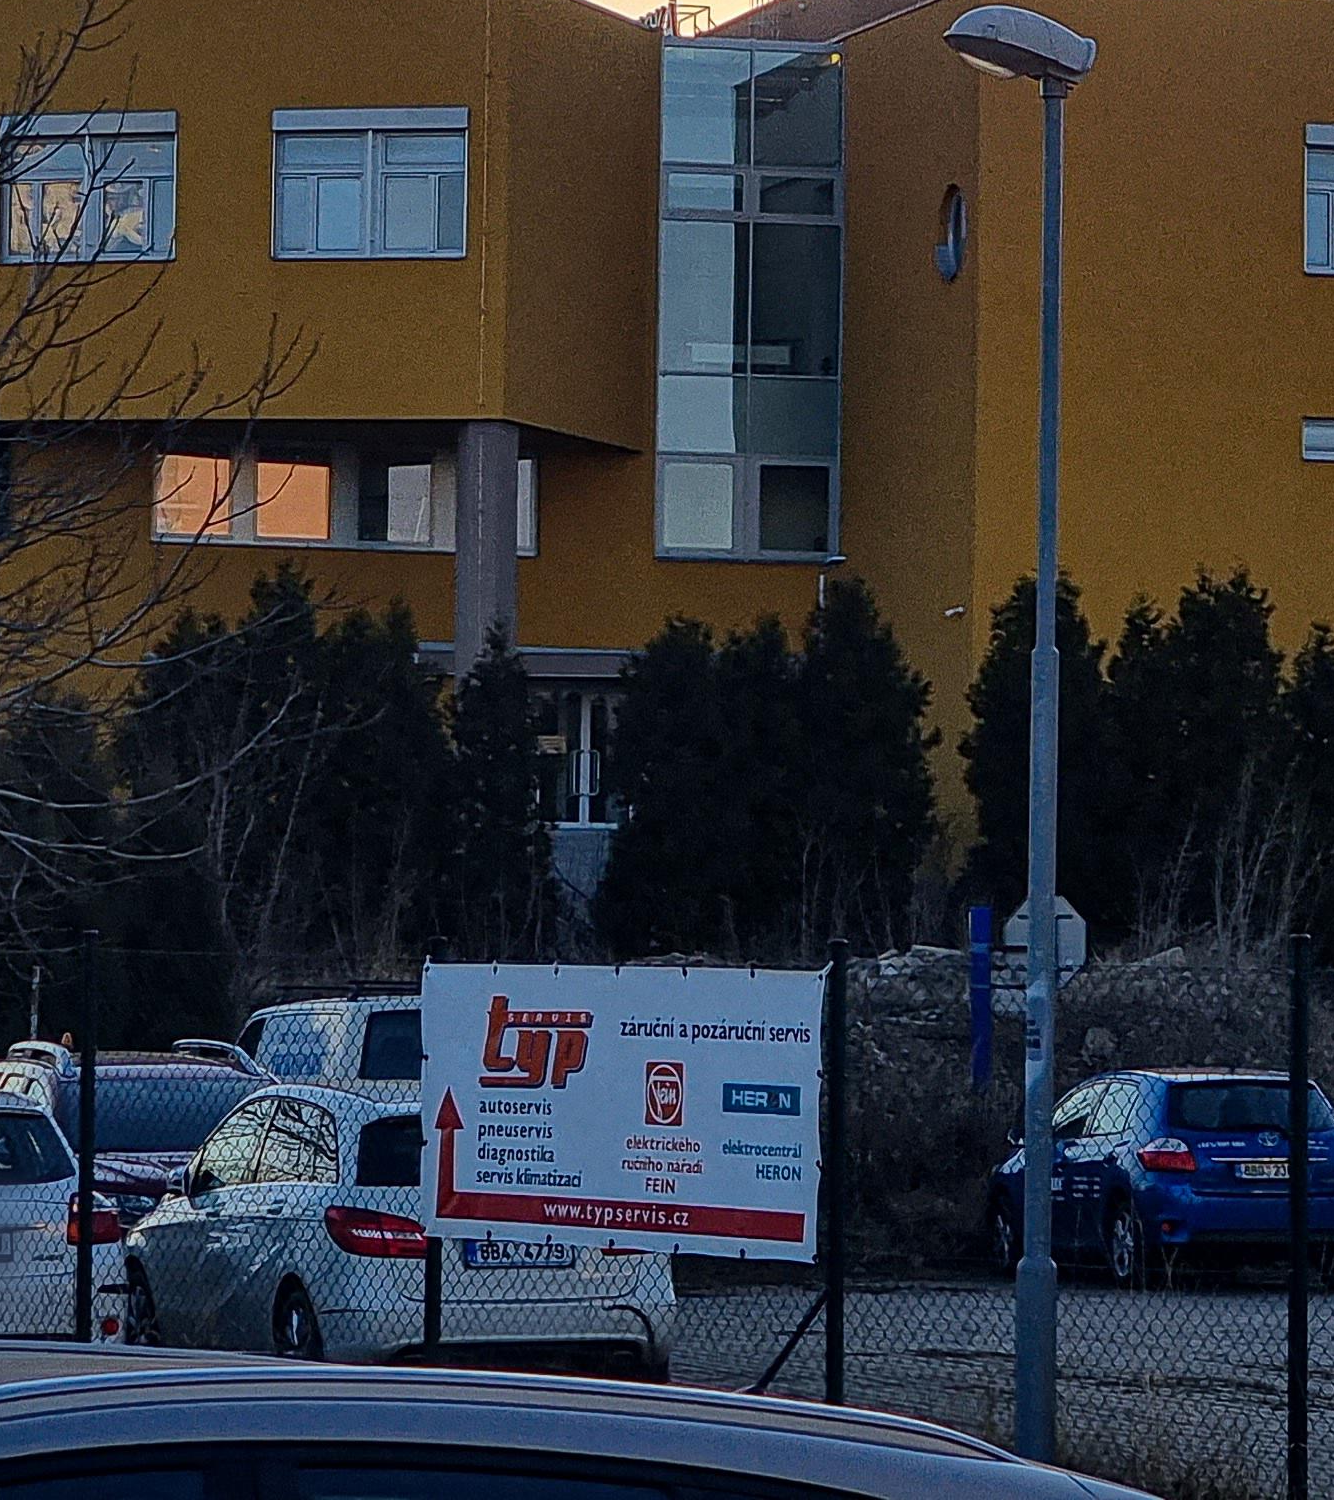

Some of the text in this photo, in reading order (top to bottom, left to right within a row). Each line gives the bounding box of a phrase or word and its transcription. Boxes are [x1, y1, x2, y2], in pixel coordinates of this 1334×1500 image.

[620, 1016, 811, 1044] záruční a pozáruční servis
[478, 995, 594, 1089] typ
[479, 1098, 552, 1115] autoservis
[731, 1089, 791, 1109] HERN
[478, 1121, 553, 1141] pneuservis
[477, 1142, 555, 1165] diagnostika
[476, 1167, 514, 1184] servis
[755, 1164, 802, 1181] HERON
[645, 1178, 676, 1194] FEIN
[543, 1203, 689, 1226] www.typservis.cz
